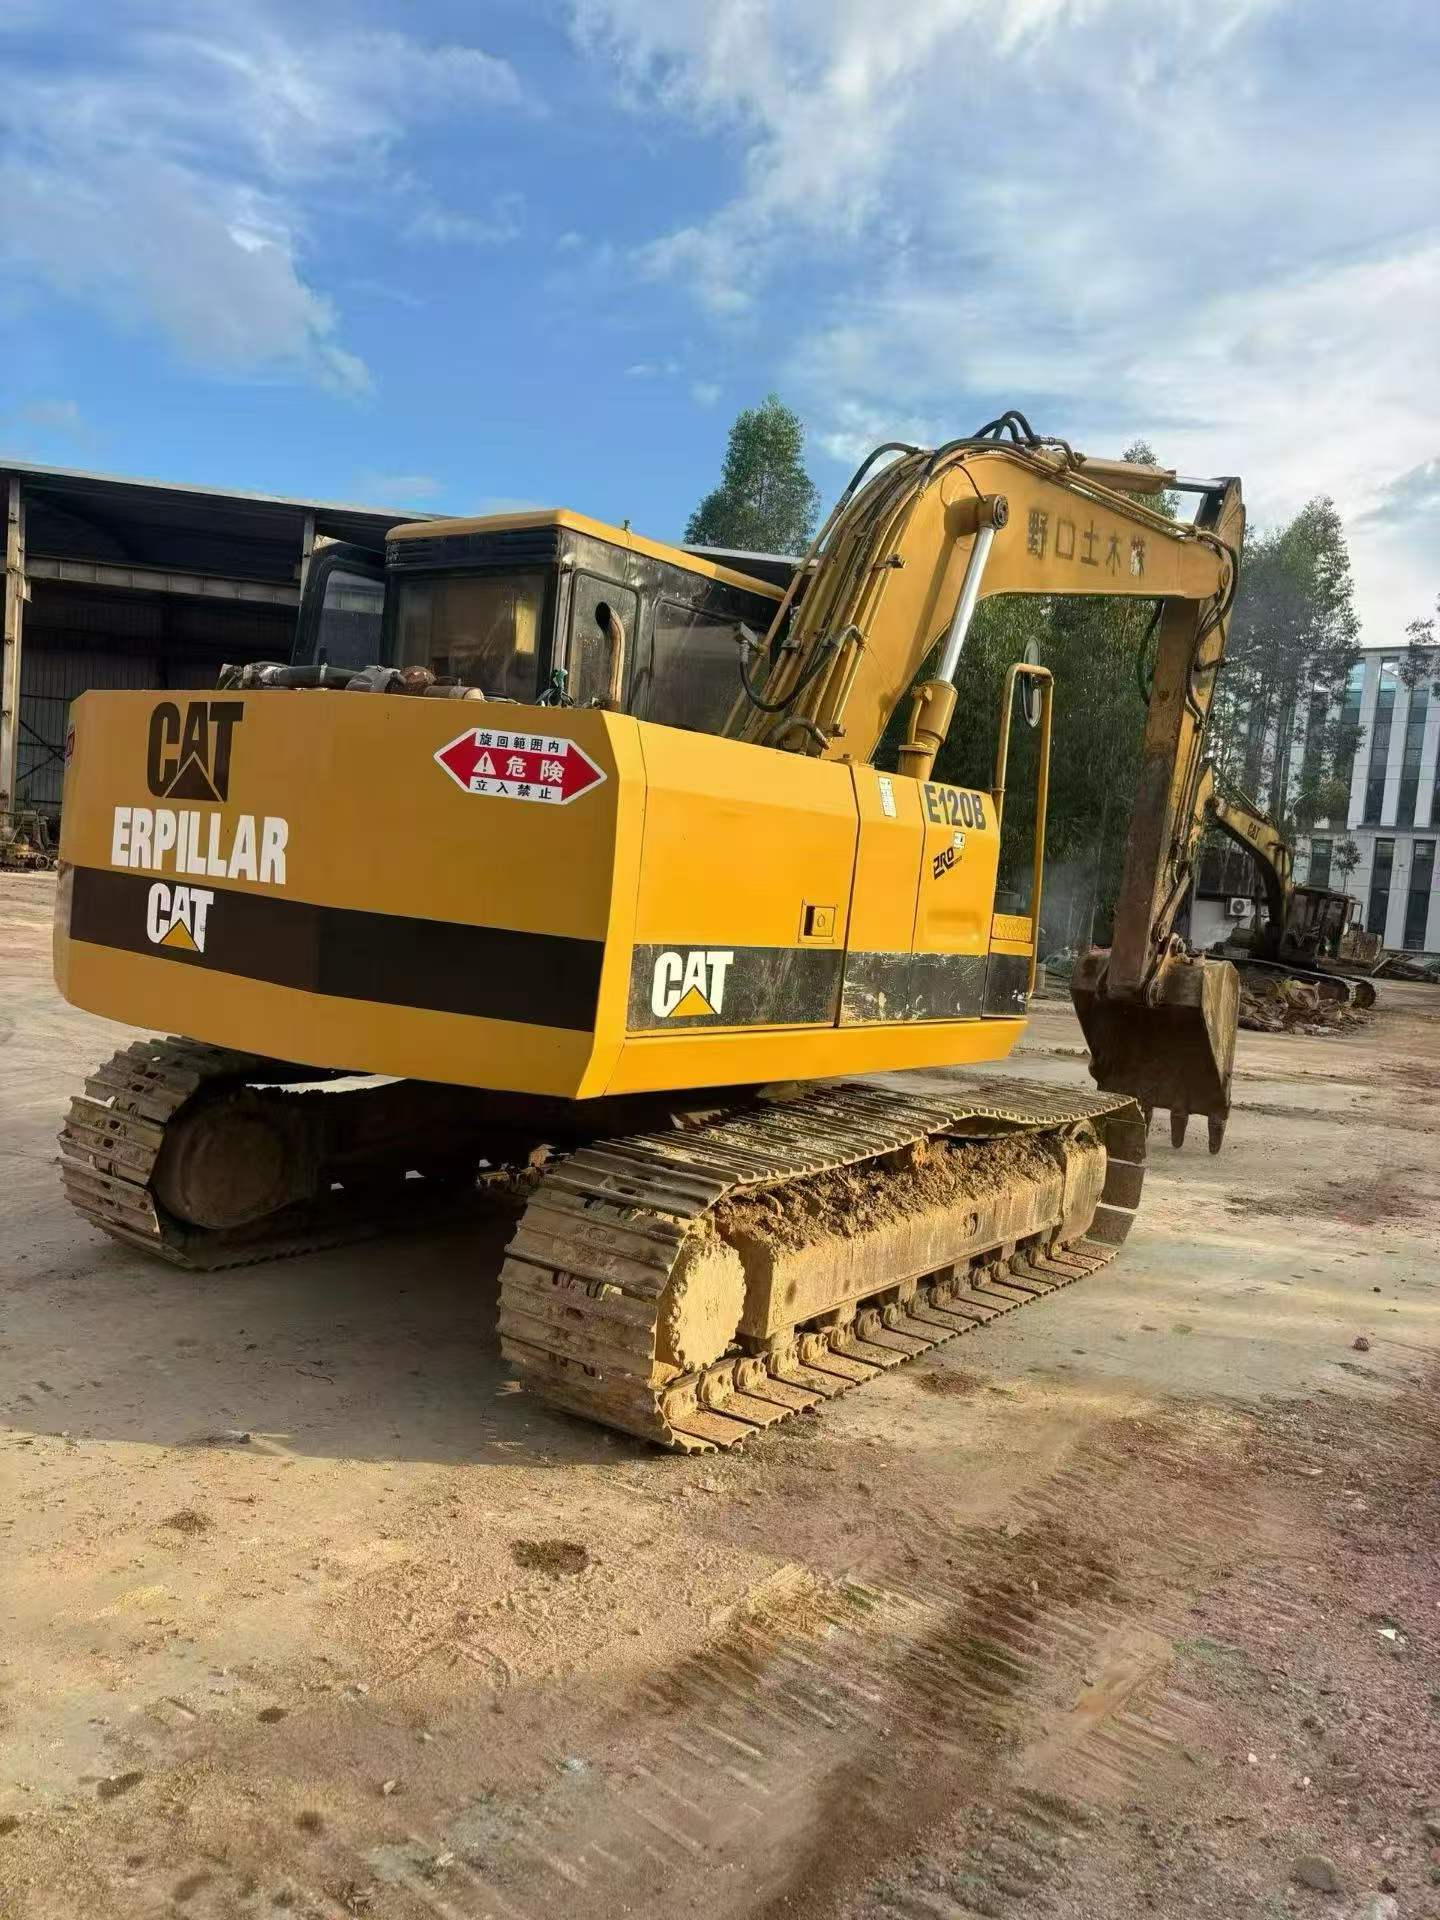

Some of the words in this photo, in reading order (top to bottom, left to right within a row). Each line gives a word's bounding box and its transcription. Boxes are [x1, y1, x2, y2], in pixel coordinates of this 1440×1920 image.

[147, 701, 245, 803] CAT
[479, 733, 559, 752] 旋回範囲内
[505, 755, 565, 784] 危険
[476, 780, 552, 799] 立入禁止
[924, 784, 987, 830] E120B
[111, 806, 289, 885] ERPILLAR
[147, 882, 214, 953] CAT
[651, 951, 734, 1017] CAT
